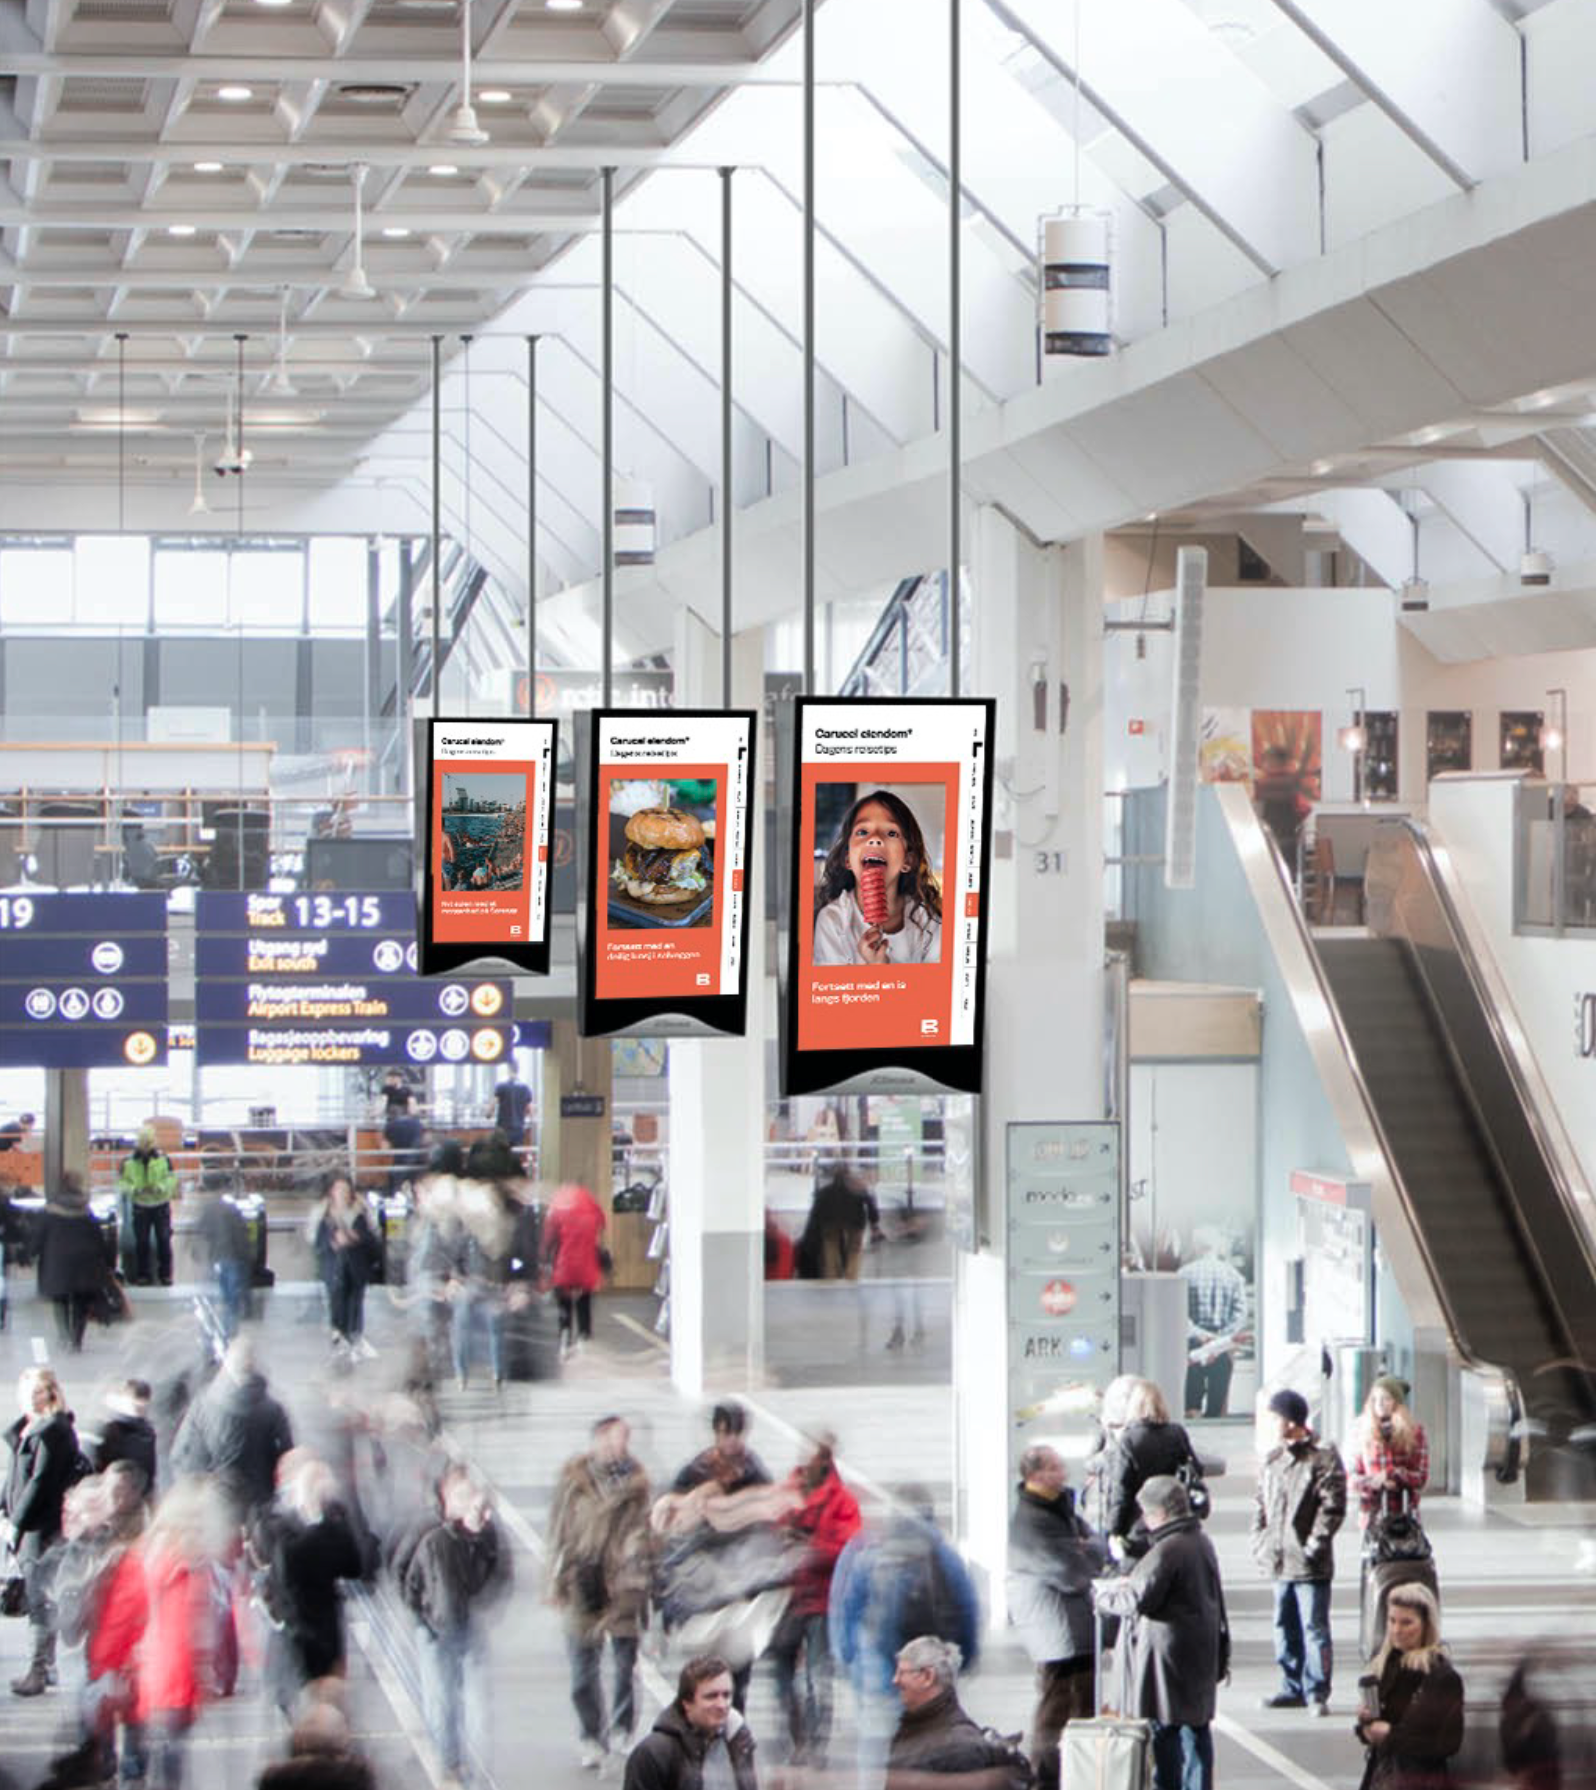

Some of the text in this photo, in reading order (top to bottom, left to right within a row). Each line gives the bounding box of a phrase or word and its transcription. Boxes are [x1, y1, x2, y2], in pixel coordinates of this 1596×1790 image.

[815, 728, 859, 739] Carucel
[1035, 851, 1061, 874] 31
[246, 910, 286, 926] Track
[295, 896, 381, 928] 13-15
[248, 955, 318, 970] Exit south
[696, 973, 711, 986] B
[856, 980, 880, 990] med
[881, 981, 895, 989] en
[811, 994, 841, 1005] langs
[248, 1000, 388, 1019] Airport Express Train
[920, 1019, 939, 1033] B
[248, 1046, 361, 1063] Luggage lockers
